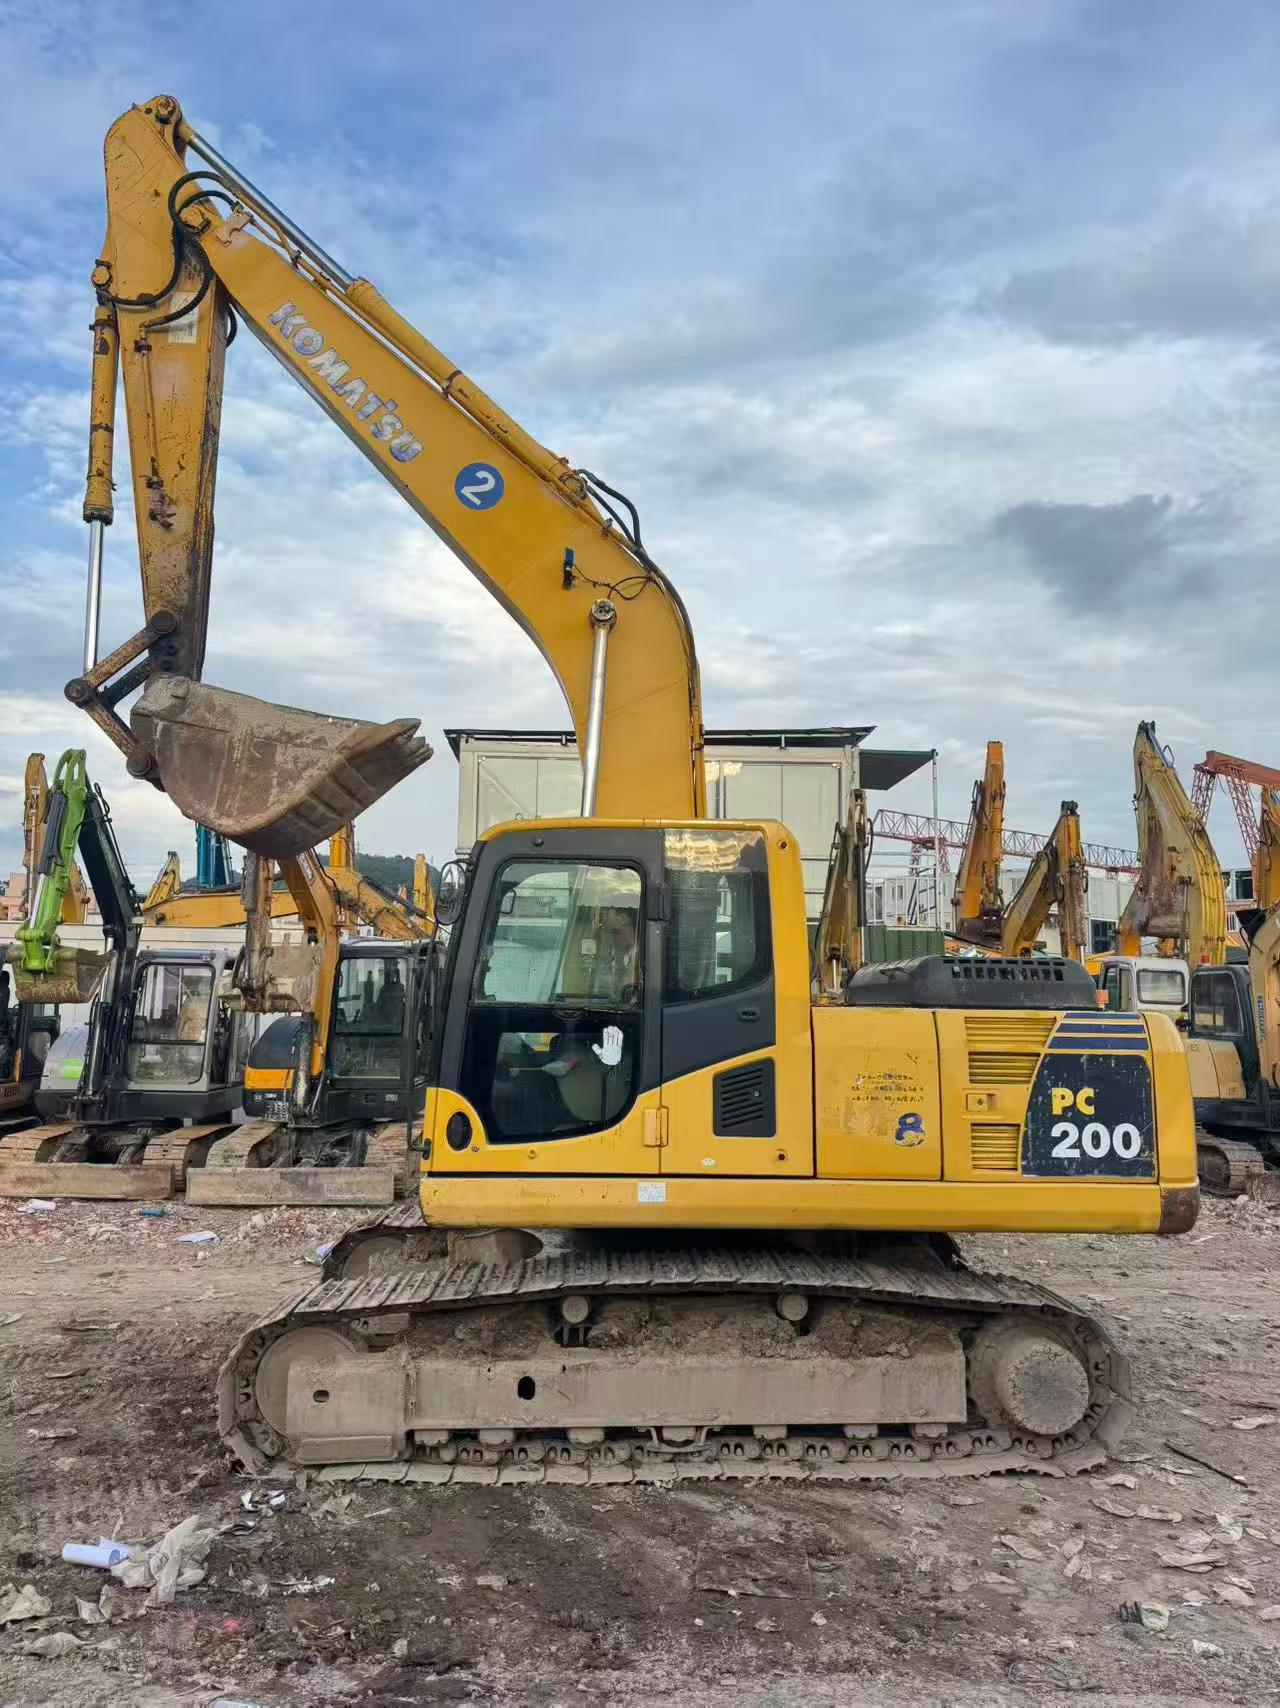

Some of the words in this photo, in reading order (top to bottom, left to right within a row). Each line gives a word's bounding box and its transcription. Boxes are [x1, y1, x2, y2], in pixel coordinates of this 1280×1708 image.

[268, 303, 424, 462] KOMATSU
[461, 471, 496, 506] 2
[1052, 1088, 1095, 1115] PC
[1051, 1122, 1141, 1159] 200
